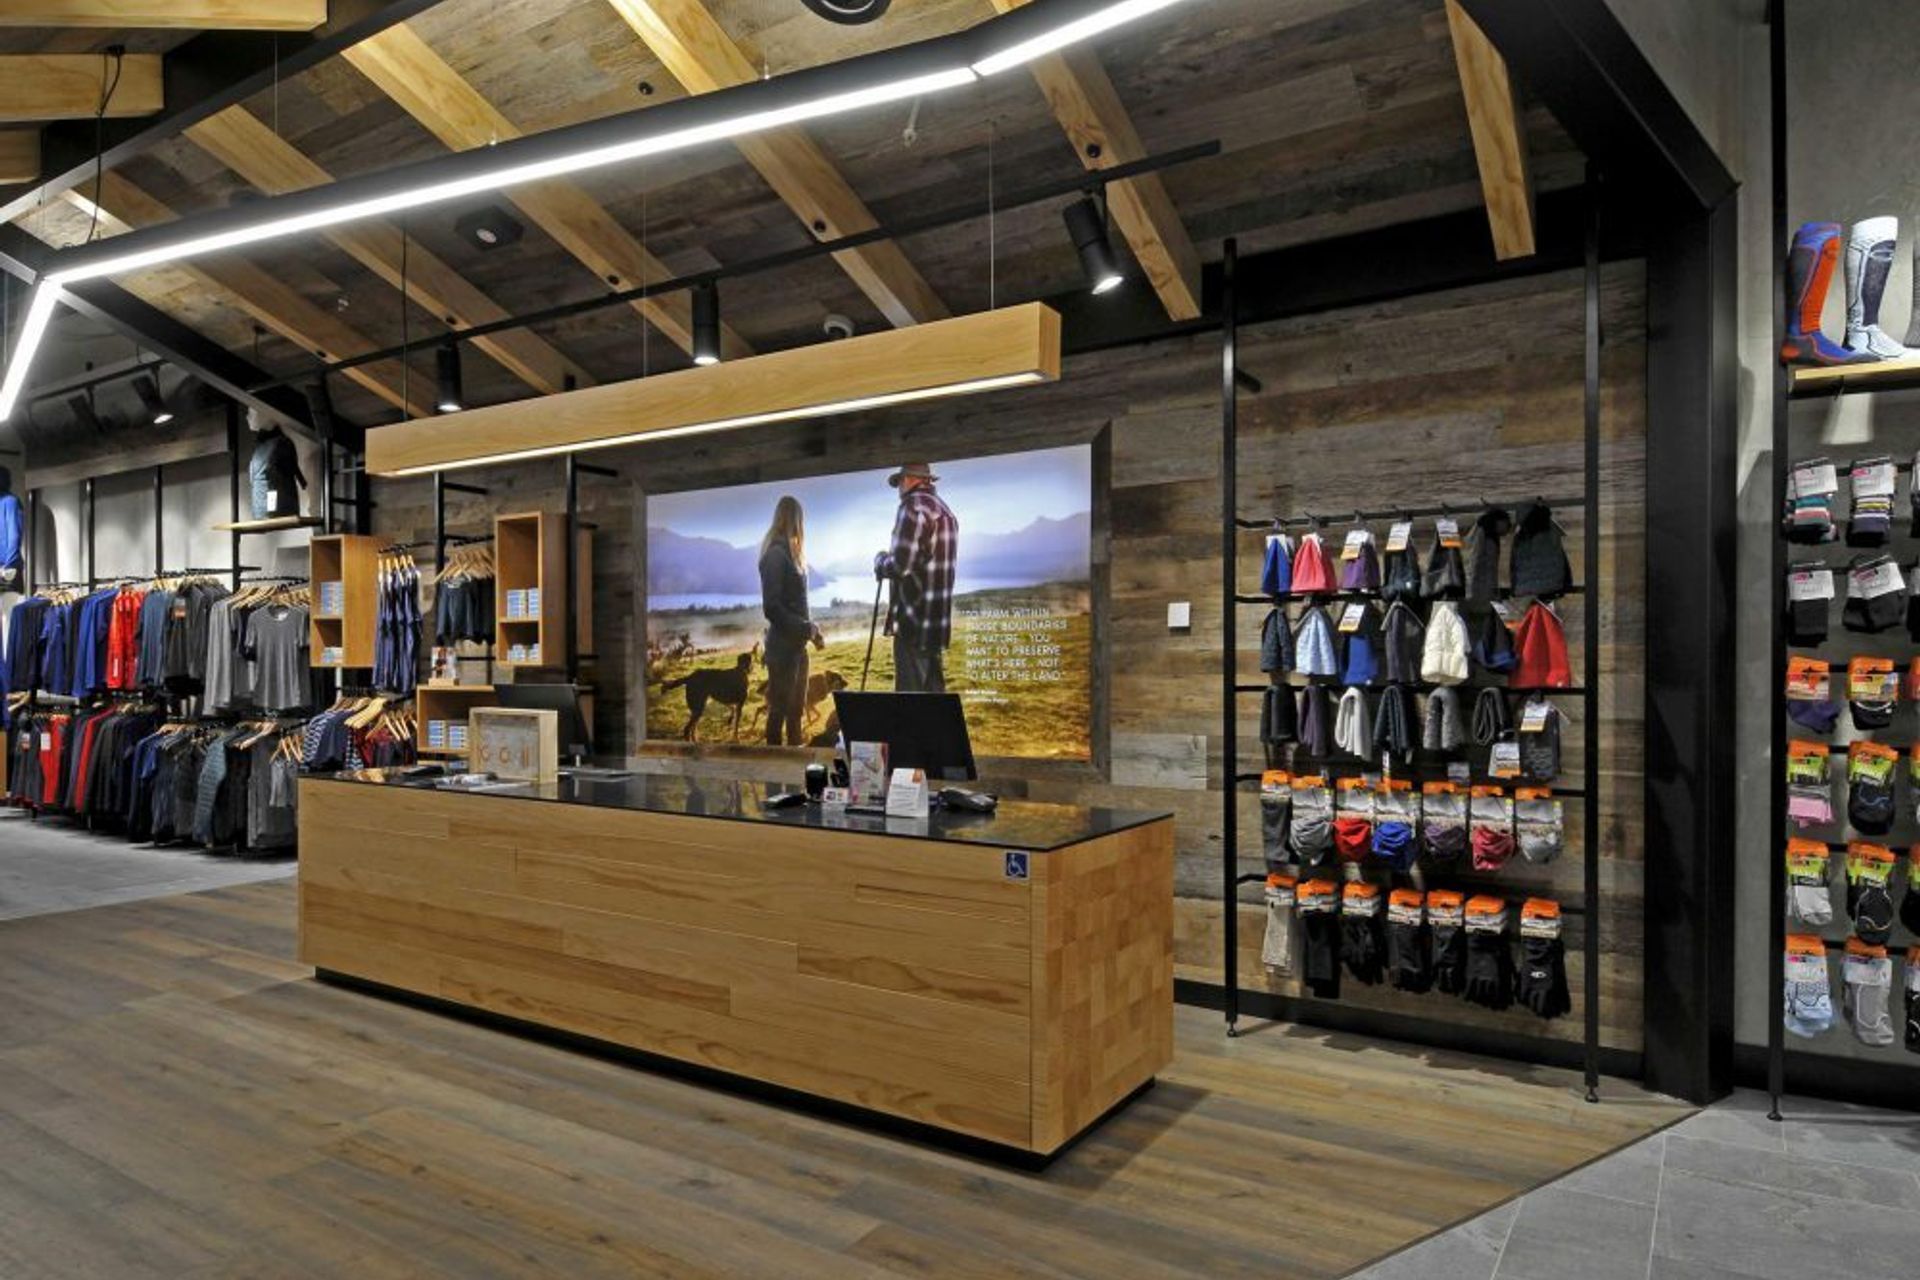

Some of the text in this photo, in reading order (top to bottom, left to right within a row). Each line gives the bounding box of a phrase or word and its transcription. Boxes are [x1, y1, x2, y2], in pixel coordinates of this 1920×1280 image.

[1029, 632, 1049, 642] YOU
[995, 645, 1009, 656] TO
[1011, 644, 1060, 656] PRESERVE
[980, 669, 1008, 681] ALTER
